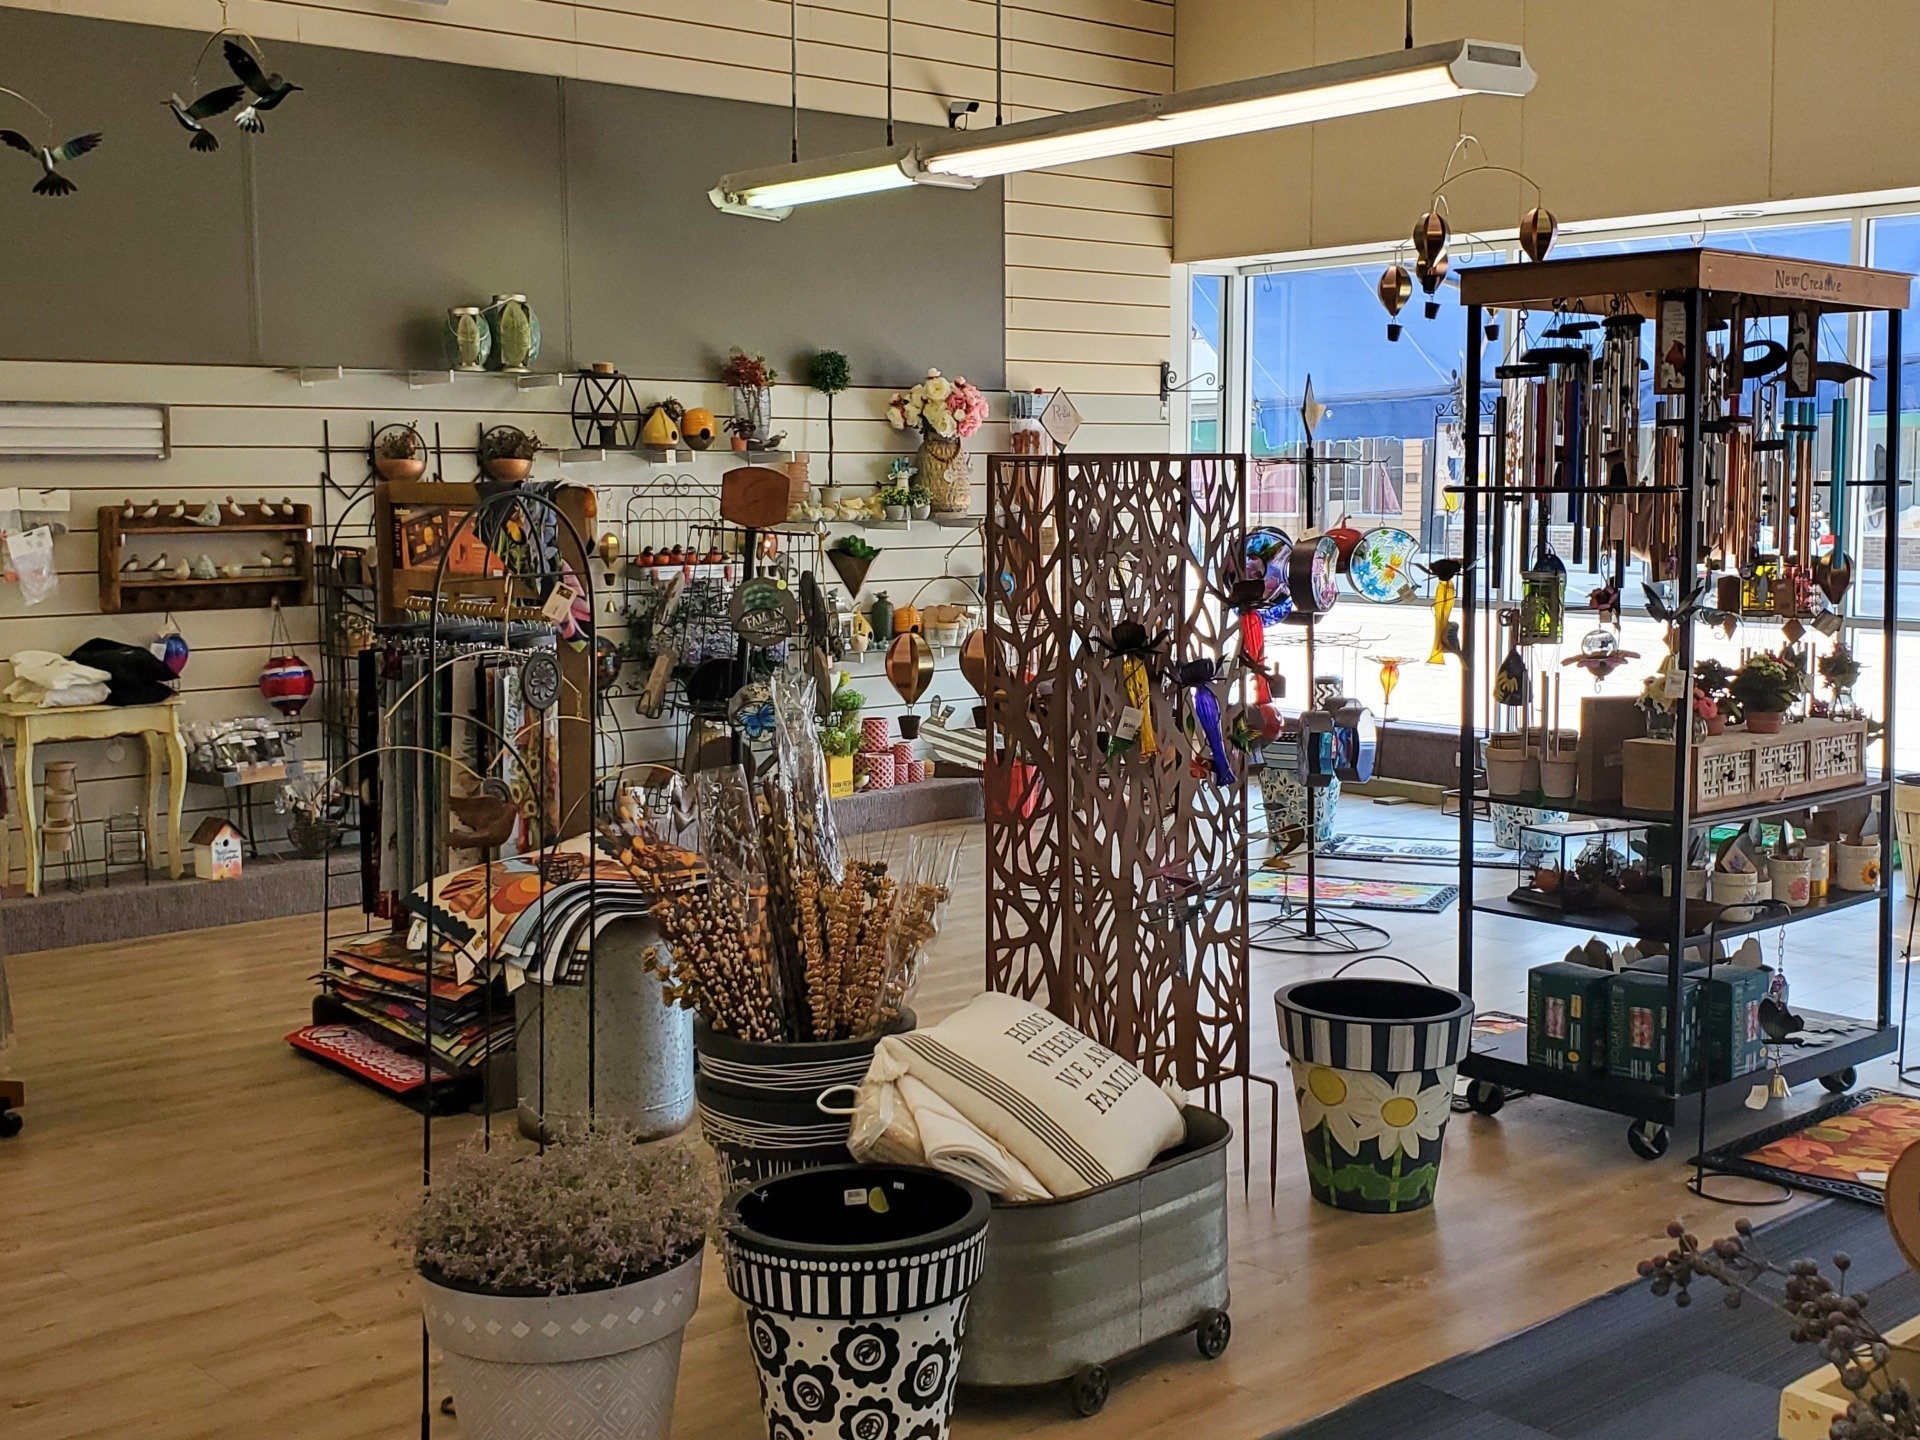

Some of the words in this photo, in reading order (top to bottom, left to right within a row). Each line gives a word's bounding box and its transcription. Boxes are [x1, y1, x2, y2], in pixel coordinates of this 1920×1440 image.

[742, 606, 784, 630] FAMLY
[1004, 1012, 1054, 1045] HOME
[1611, 1000, 1620, 1030] LIGHT
[1027, 1026, 1086, 1067] WHERE
[1055, 1061, 1093, 1090] WE
